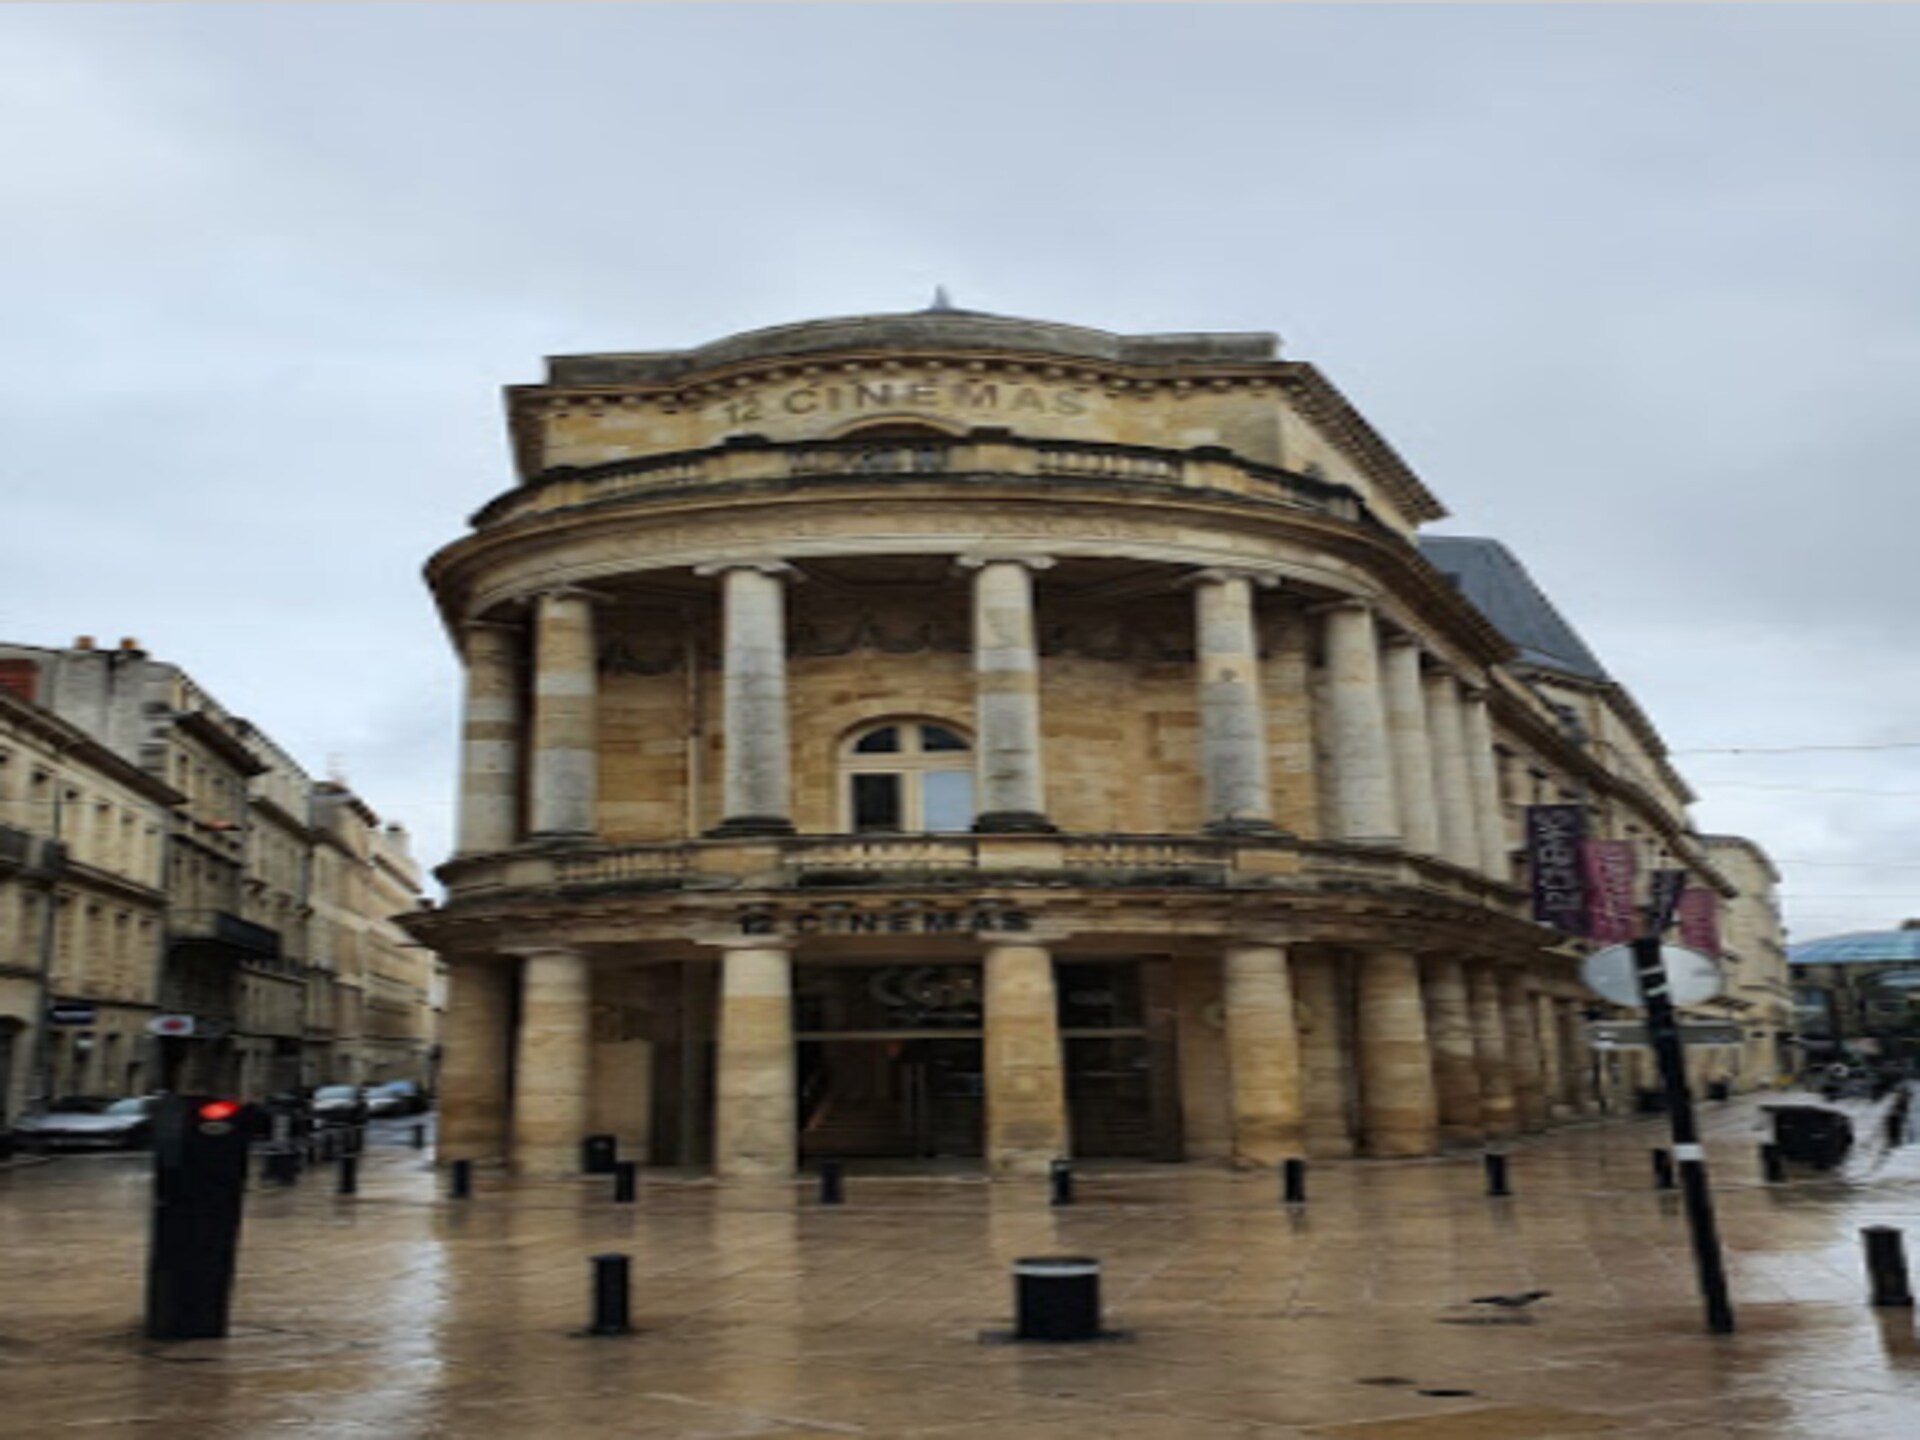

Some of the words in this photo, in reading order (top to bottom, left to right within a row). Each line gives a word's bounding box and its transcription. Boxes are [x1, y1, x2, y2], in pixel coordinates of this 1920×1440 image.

[725, 401, 762, 425] 12
[783, 382, 1089, 416] CINEMAS
[797, 909, 1032, 933] CINEMAS
